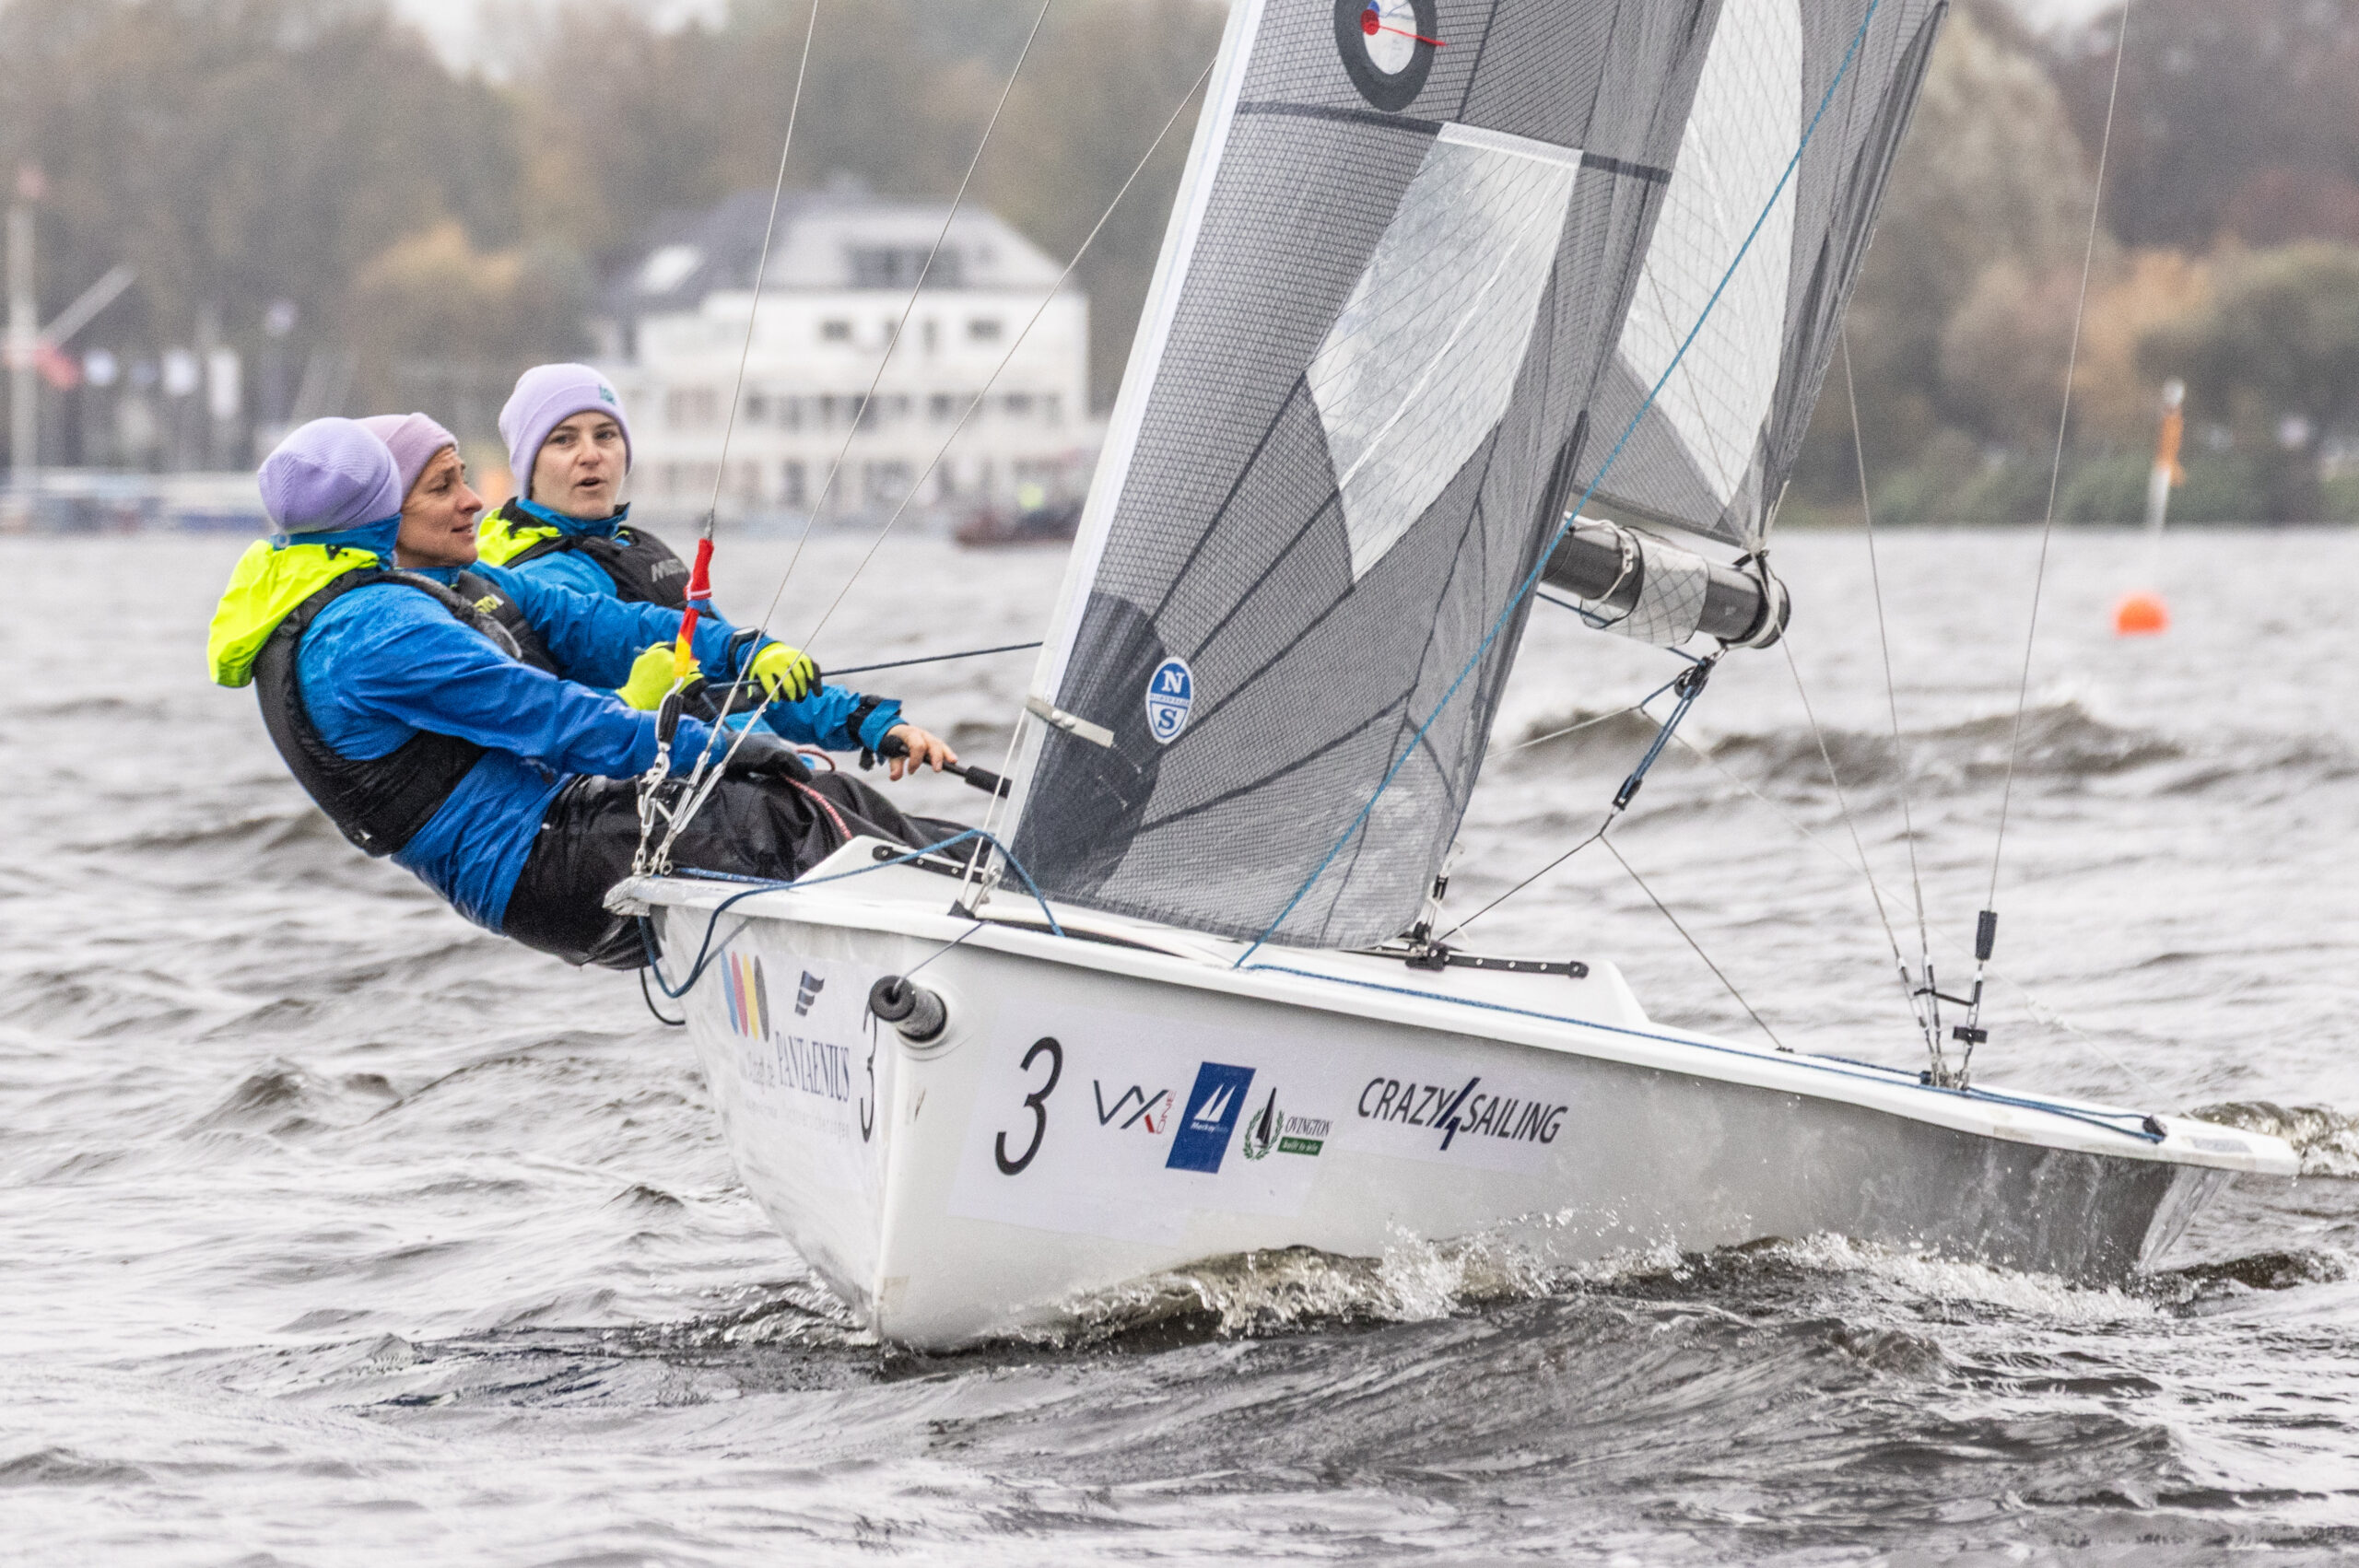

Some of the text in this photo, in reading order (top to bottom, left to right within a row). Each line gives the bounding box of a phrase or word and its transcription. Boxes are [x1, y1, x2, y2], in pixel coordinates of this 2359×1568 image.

[1161, 670, 1186, 695] N
[1157, 708, 1178, 731] S
[775, 1030, 851, 1103] PANTAENIUS
[860, 993, 877, 1143] 3
[995, 1036, 1063, 1176] 3
[1285, 1116, 1334, 1138] OVINGTON
